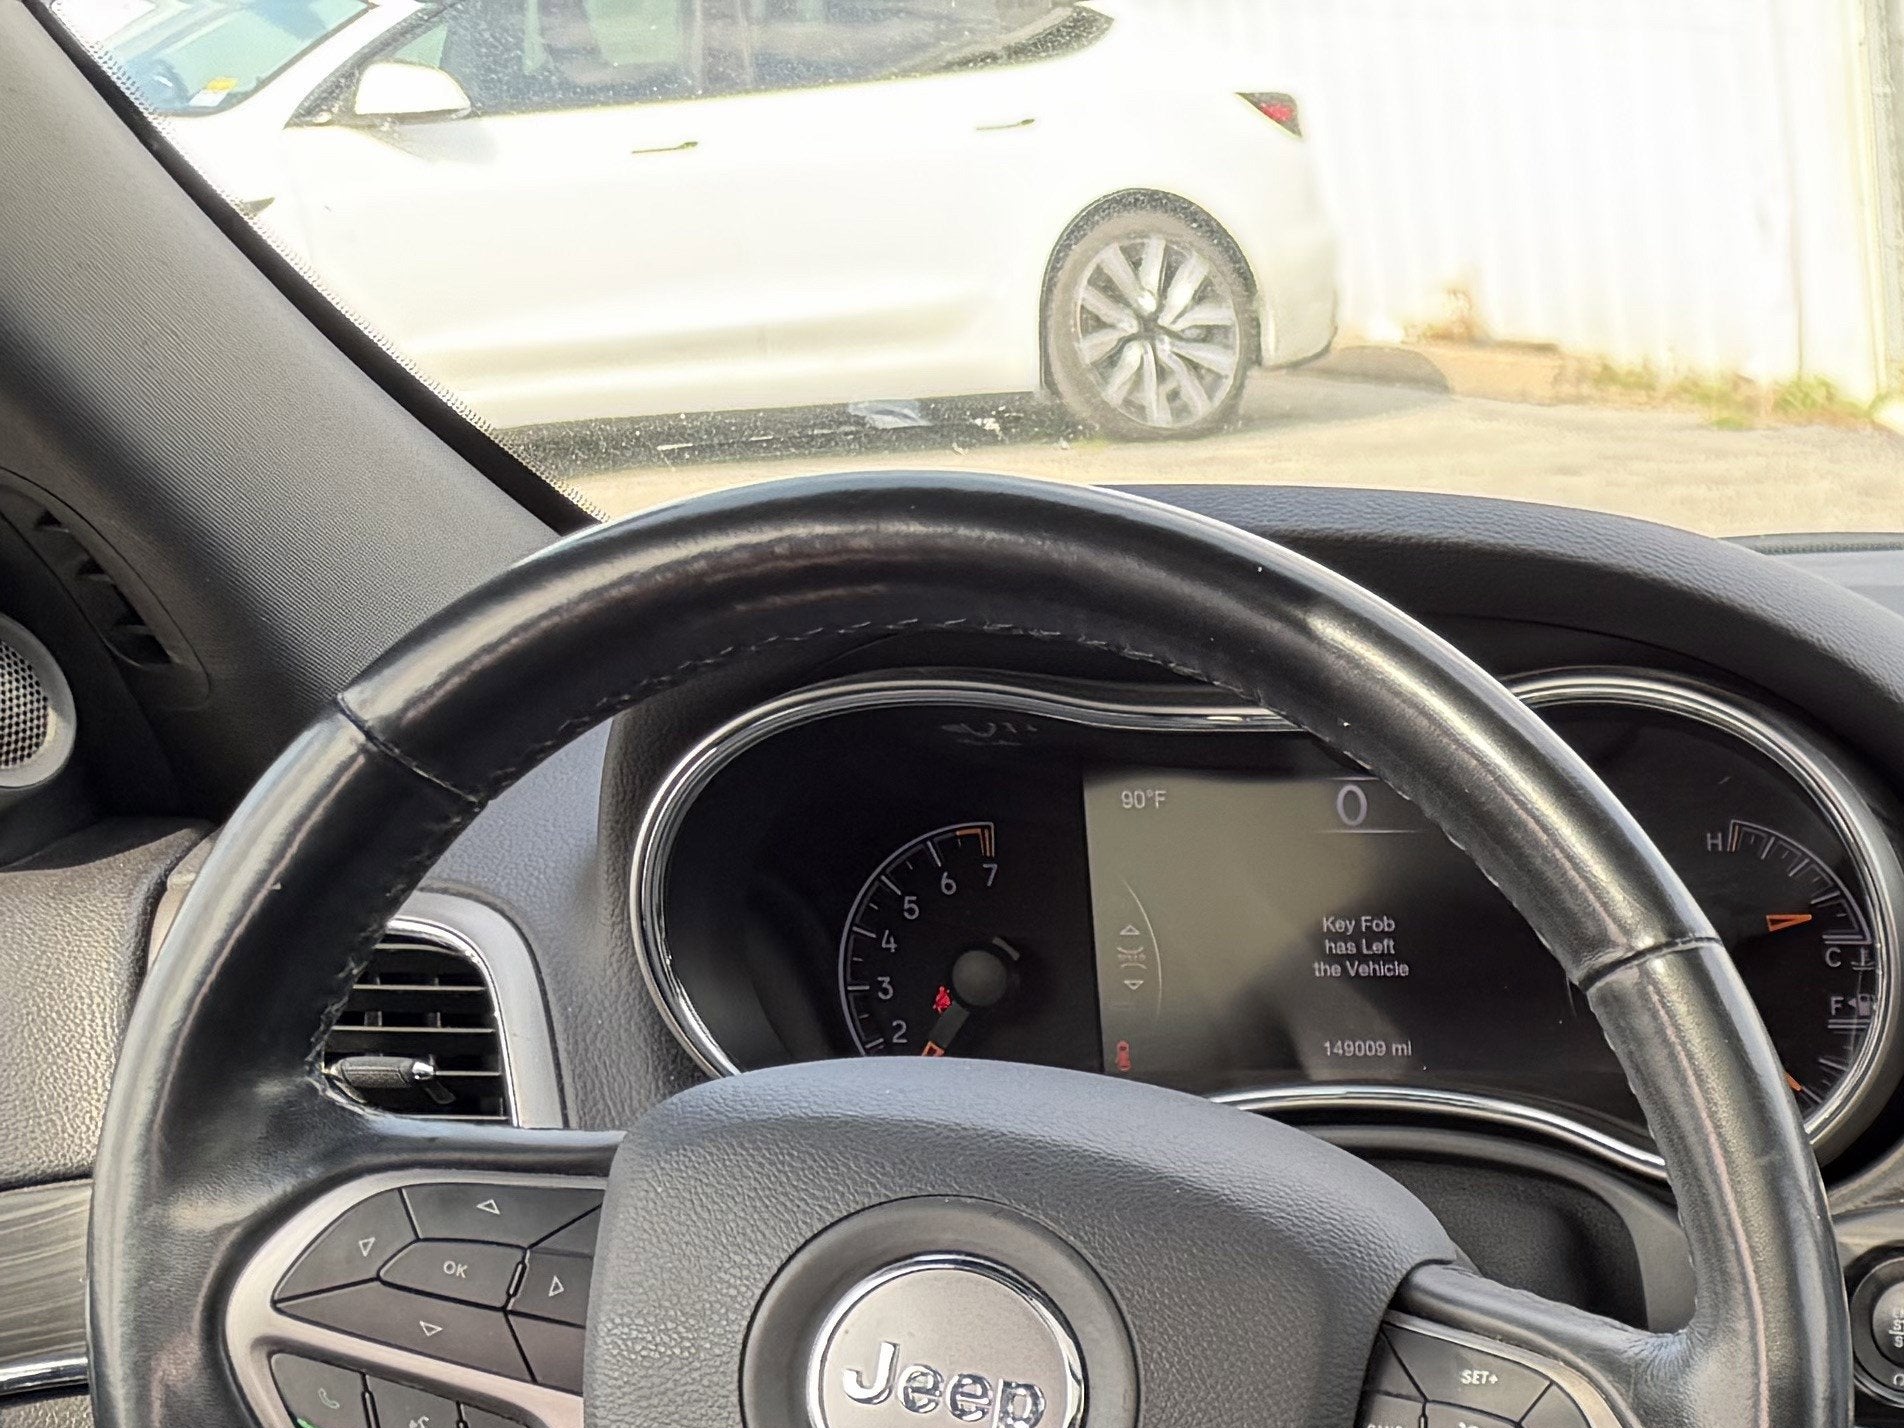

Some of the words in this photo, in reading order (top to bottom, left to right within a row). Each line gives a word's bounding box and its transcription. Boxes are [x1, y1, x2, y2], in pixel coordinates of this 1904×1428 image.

[1706, 832, 1723, 852] H
[940, 871, 957, 895] 6
[982, 863, 998, 887] 7
[903, 896, 920, 920] 5
[1322, 916, 1356, 934] Key
[1361, 915, 1396, 933] Fob
[881, 929, 898, 952] 4
[1325, 938, 1357, 955] has
[1362, 938, 1396, 955] Left
[1825, 947, 1842, 968] C
[1313, 961, 1342, 978] the
[1345, 961, 1410, 978] Vehicle
[876, 976, 894, 1000] 3
[1830, 996, 1845, 1016] F
[891, 1019, 908, 1044] 2
[443, 1260, 469, 1279] OK
